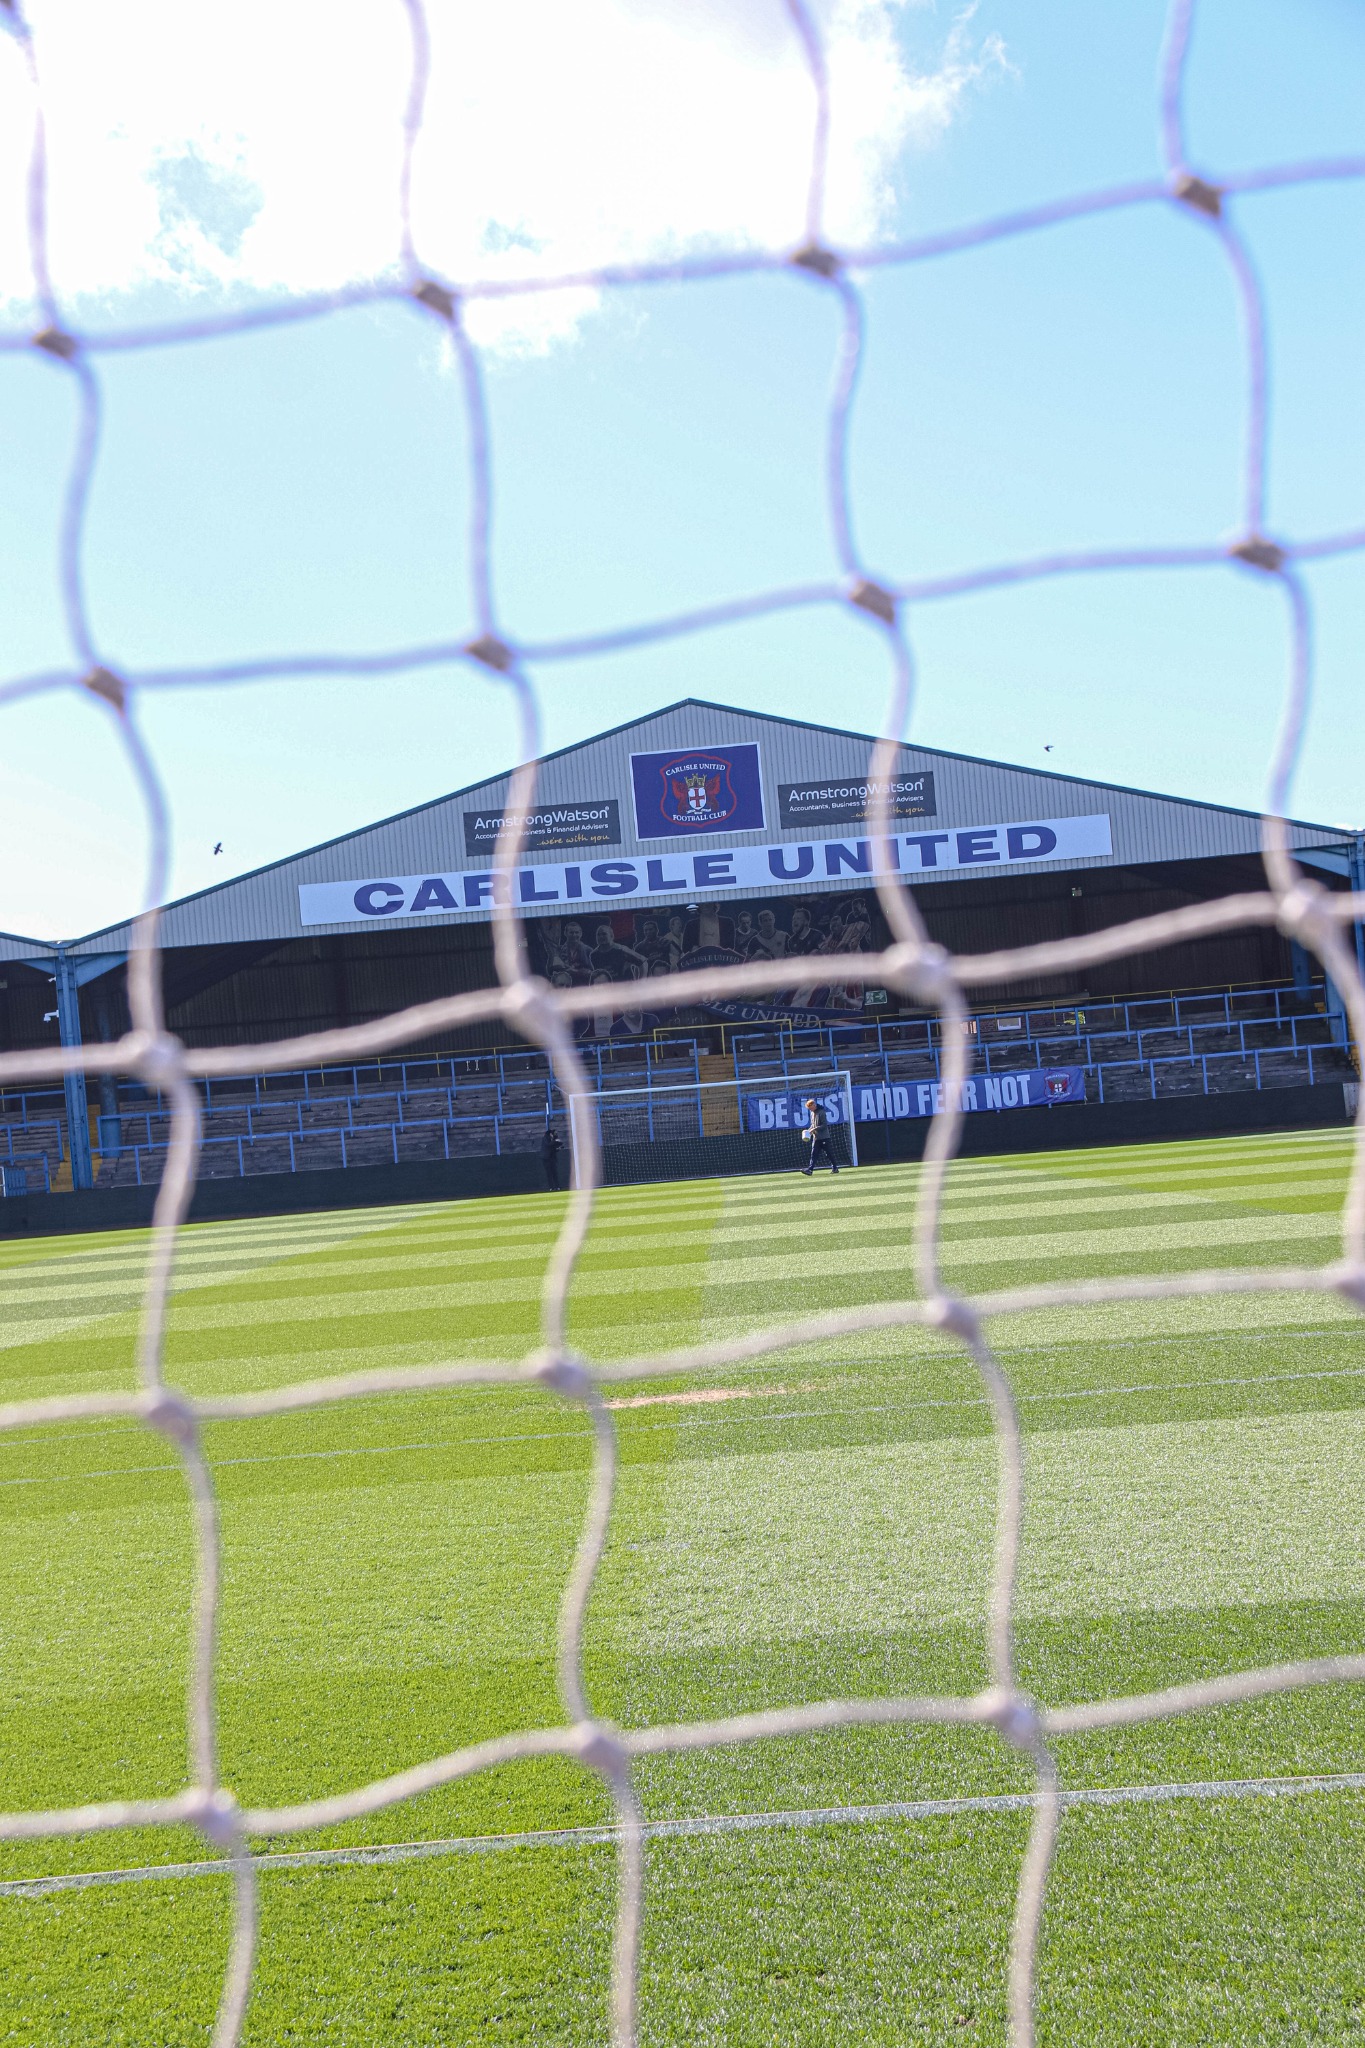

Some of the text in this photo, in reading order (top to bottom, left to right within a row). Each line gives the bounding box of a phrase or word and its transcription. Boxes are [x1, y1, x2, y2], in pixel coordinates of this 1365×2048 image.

[665, 763, 726, 776] CARLISLE UNITED
[832, 801, 860, 809] Business
[868, 797, 896, 805] Finial
[673, 814, 709, 822] FOOTBALL
[710, 810, 727, 820] CLUB
[905, 807, 926, 816] you
[518, 828, 545, 836] usiness
[553, 825, 580, 833] Financial
[581, 823, 609, 831] Advisers
[566, 835, 588, 843] with
[590, 835, 611, 844] you
[353, 825, 1057, 916] CARLISLE UNITED
[758, 1097, 789, 1129] BE
[793, 1091, 850, 1127] JST
[860, 1087, 910, 1120] AND
[984, 1074, 1030, 1108] NOT
